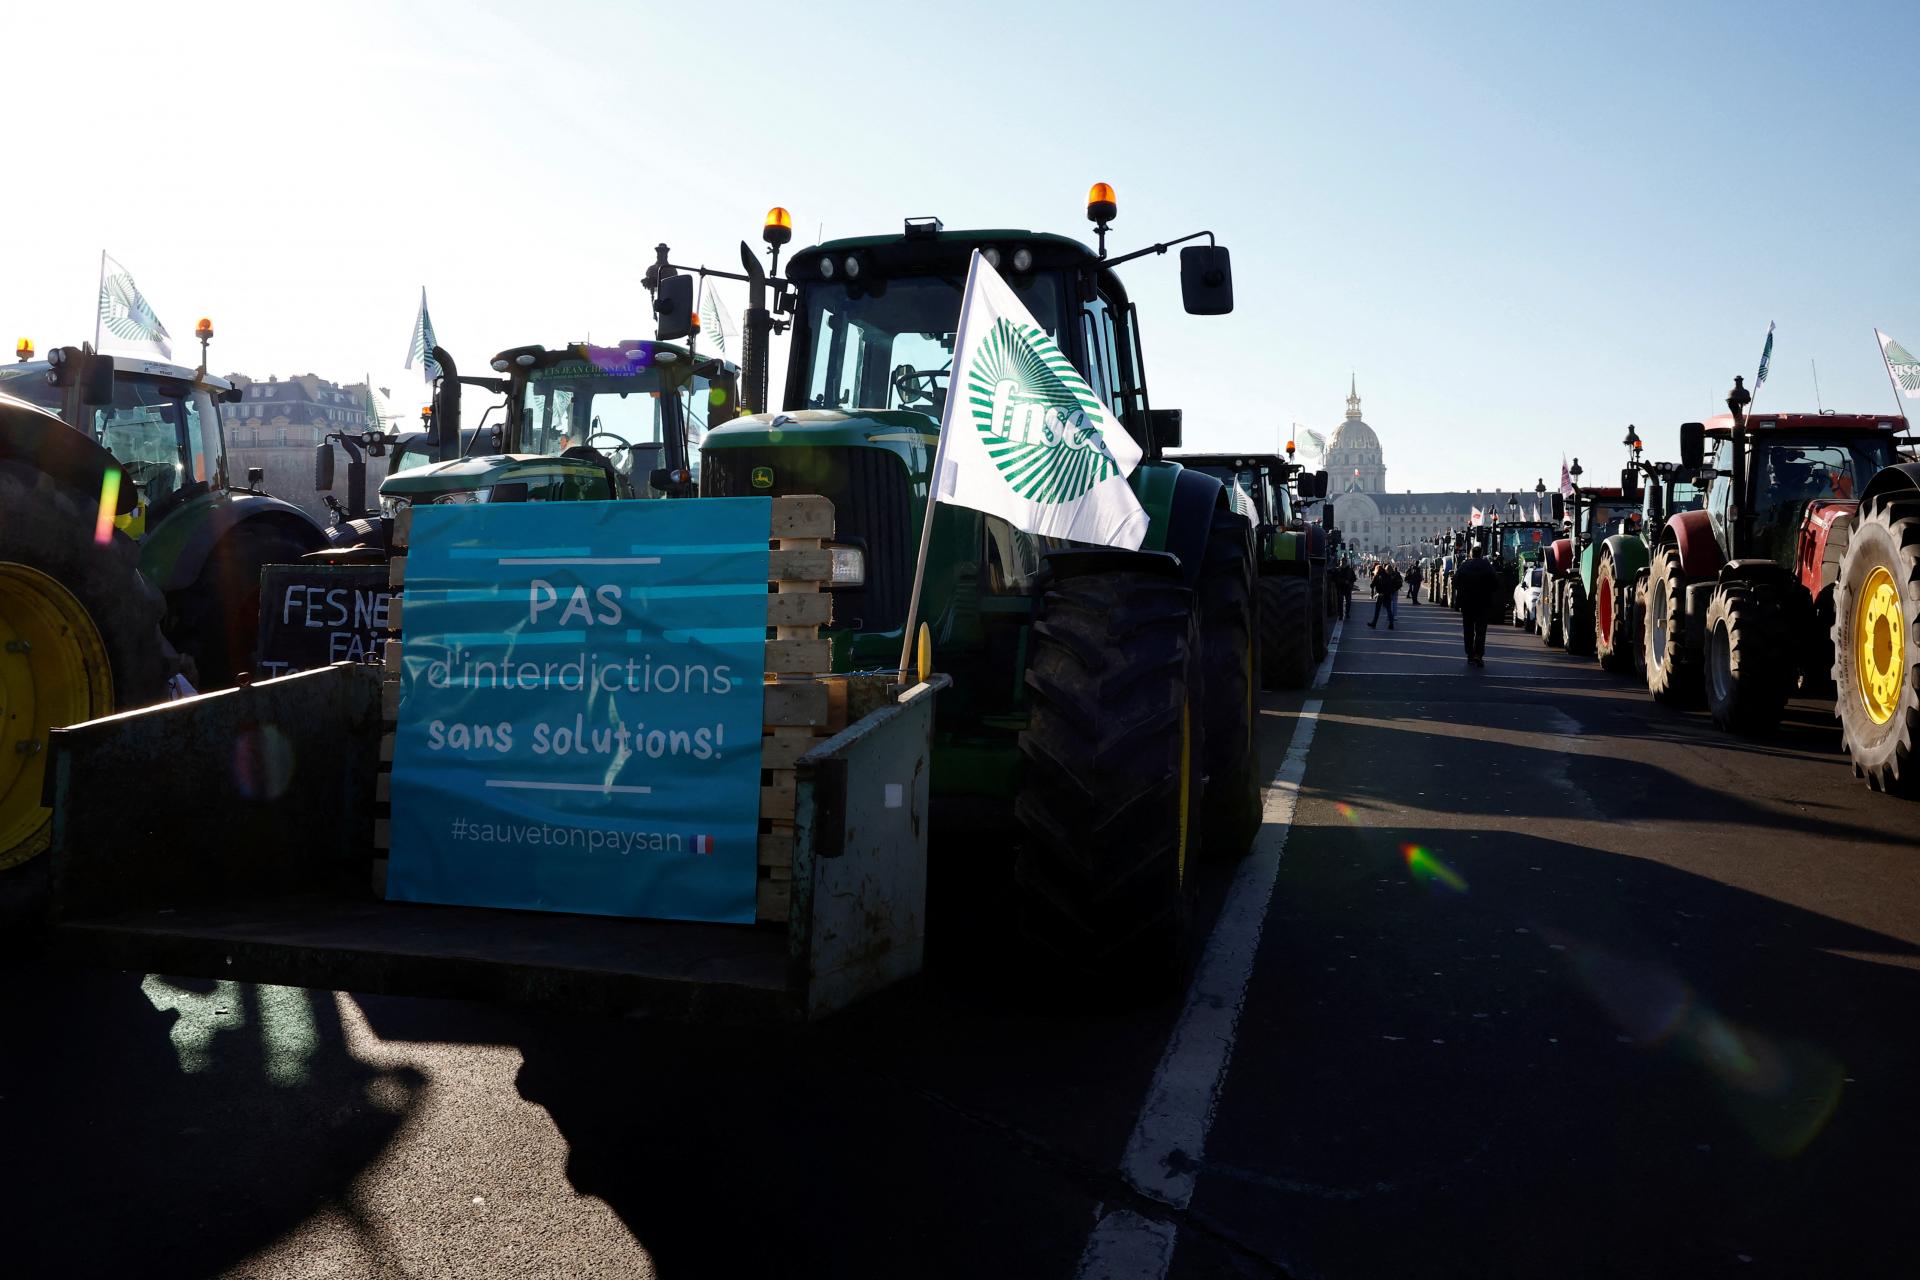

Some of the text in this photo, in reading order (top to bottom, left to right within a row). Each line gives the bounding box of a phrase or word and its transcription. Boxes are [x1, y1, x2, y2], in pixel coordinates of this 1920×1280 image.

[283, 585, 404, 629] FESNE
[530, 579, 622, 626] PAS
[428, 651, 732, 695] d'interdictions
[428, 713, 724, 760] sans solutions!
[451, 817, 682, 855] #sauvetonpaysan
